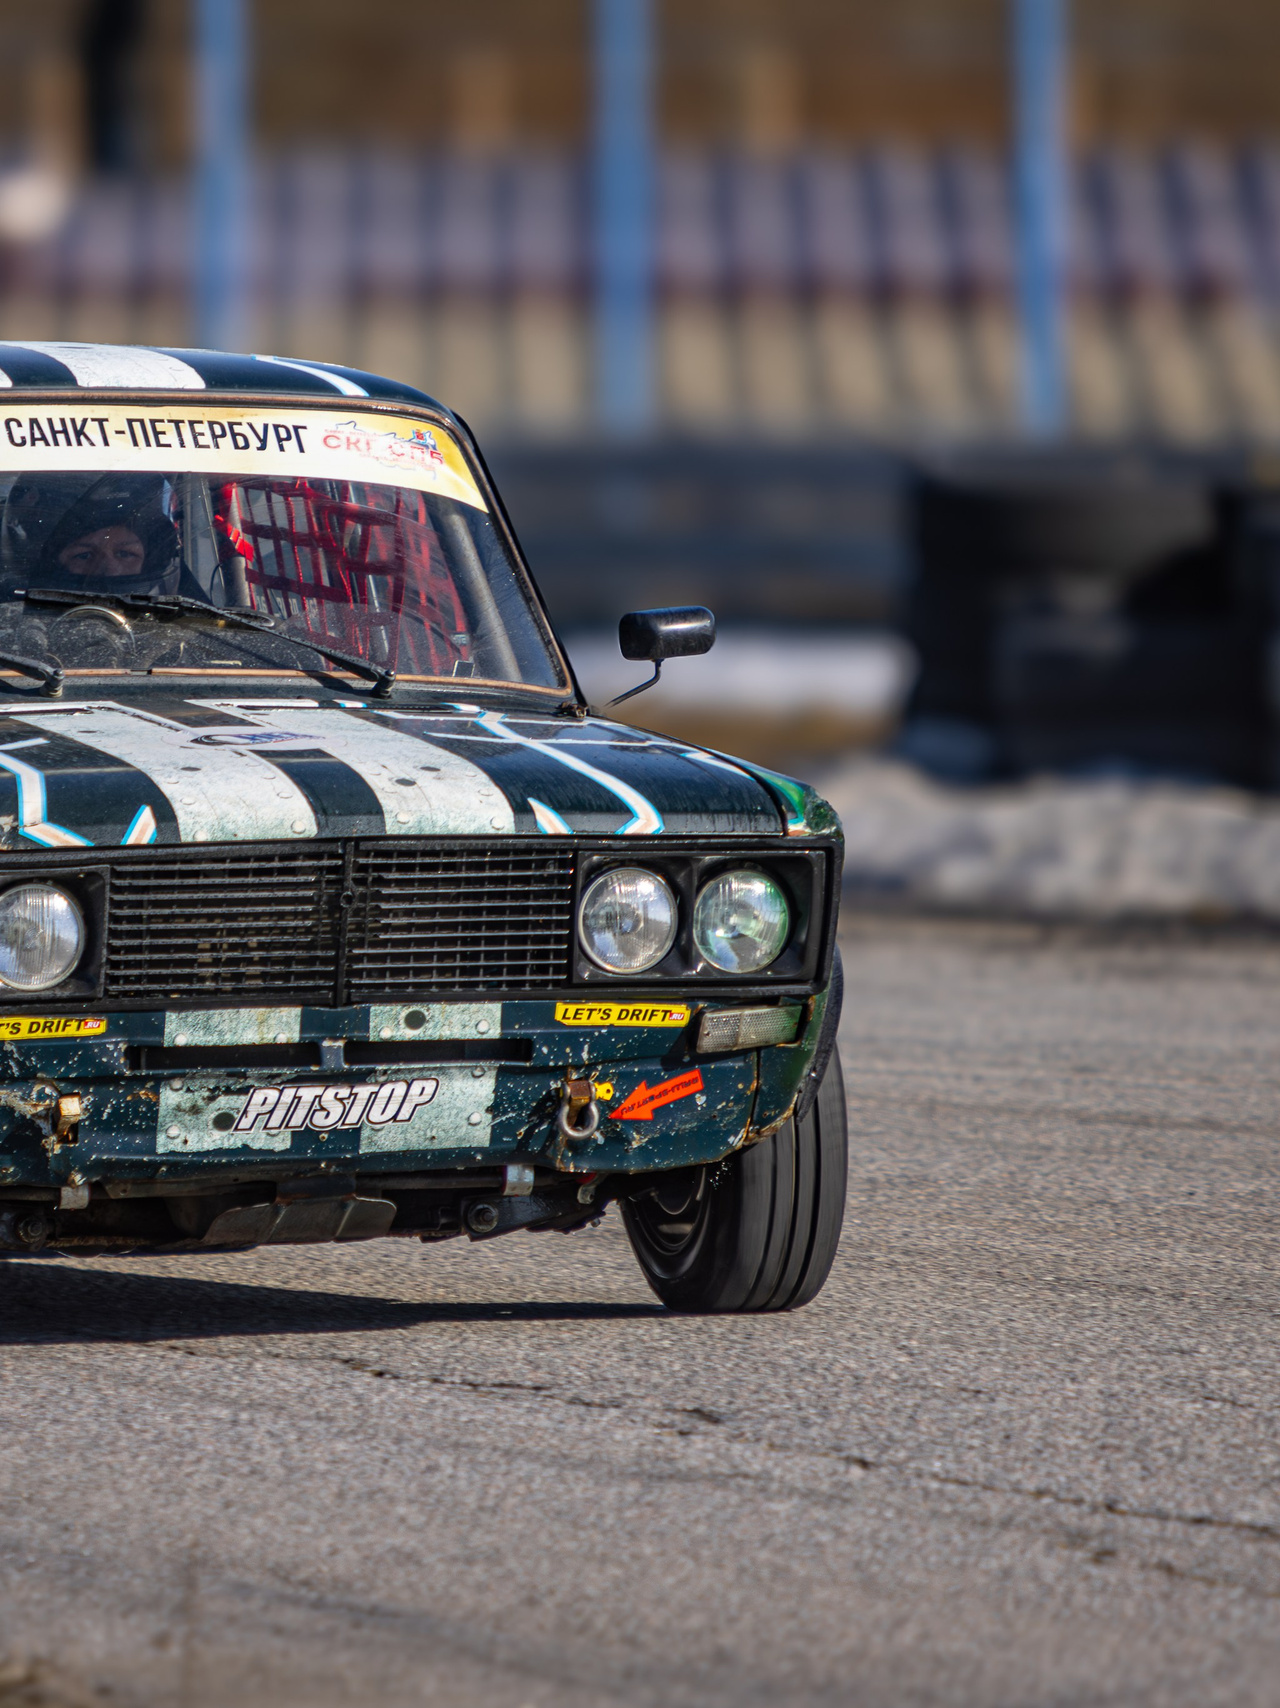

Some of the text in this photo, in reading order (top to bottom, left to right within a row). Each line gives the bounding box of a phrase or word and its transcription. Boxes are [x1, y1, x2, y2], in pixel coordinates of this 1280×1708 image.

[4, 417, 308, 454] САНКТ-ПЕТЕРБУРГ
[562, 1008, 612, 1020] LET'S
[231, 1077, 439, 1133] PITSTOP
